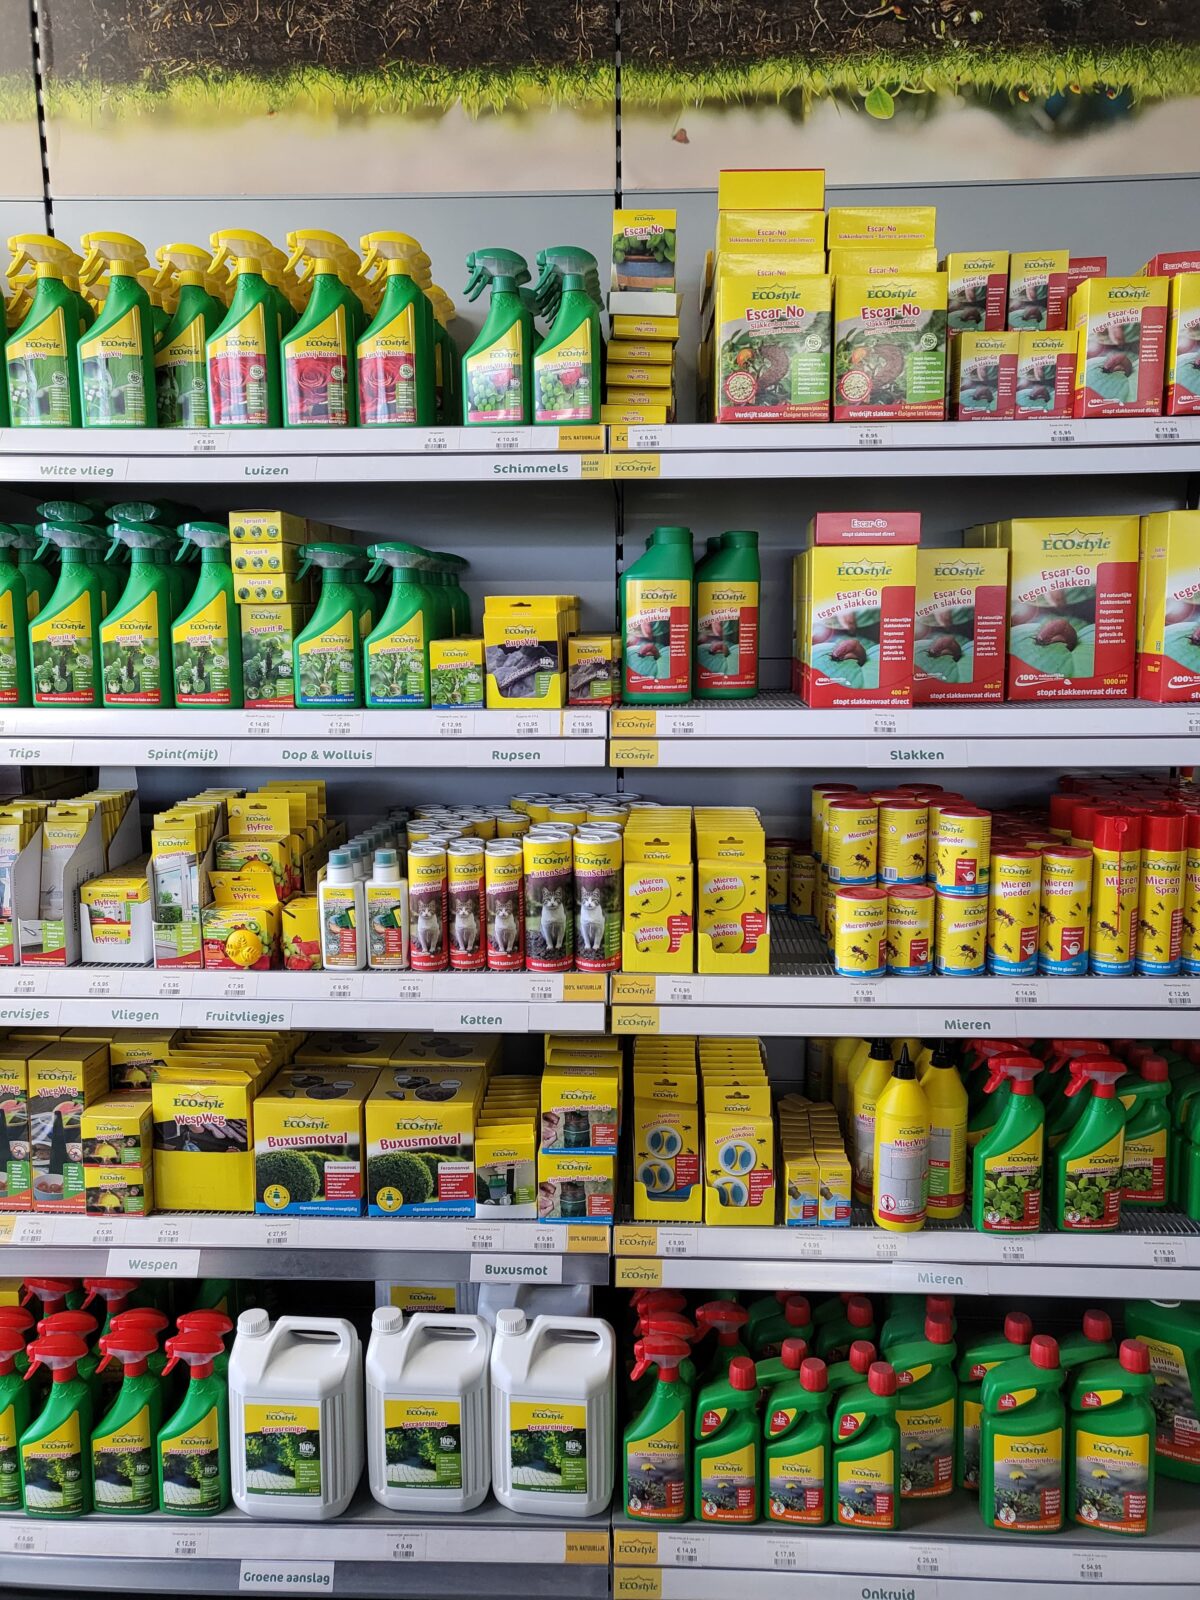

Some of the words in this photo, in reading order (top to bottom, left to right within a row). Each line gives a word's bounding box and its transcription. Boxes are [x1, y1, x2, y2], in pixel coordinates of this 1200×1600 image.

[624, 225, 664, 238] Escar-No
[867, 225, 897, 233] Escar-No
[752, 291, 802, 302] ECOstyle
[867, 289, 917, 301] ECOstyle
[1108, 290, 1151, 301] ECOstyle
[746, 307, 805, 321] Escar-No
[861, 306, 921, 320] Escar-No
[1107, 308, 1139, 320] Escar-Go
[40, 464, 78, 476] Witte
[80, 464, 115, 479] vlieg
[244, 466, 290, 476] Luizen
[492, 463, 569, 474] Schimmels
[615, 465, 658, 473] ECOstyle
[850, 518, 888, 530] Escar-Go
[1040, 536, 1112, 555] ECOstyle
[836, 566, 894, 578] ECOstyle
[933, 567, 987, 578] ECOstyle
[1041, 565, 1091, 582] Escar-Go
[1050, 576, 1091, 592] slakken
[640, 592, 678, 602] ECOstyle
[711, 593, 748, 603] ECOstyle
[836, 588, 878, 601] Escar-Go
[933, 587, 972, 600] Escar-Go
[843, 598, 878, 610] slakken
[941, 597, 972, 608] slakken
[930, 692, 946, 700] stopt
[1036, 689, 1057, 699] stopt
[1057, 689, 1104, 697] slakkenvraat
[1105, 688, 1128, 697] direct
[833, 698, 850, 706] stopt
[851, 698, 888, 706] slakkenvraat
[890, 698, 910, 706] direct
[615, 721, 656, 731] ECOstyle
[8, 747, 42, 760] Trips
[147, 748, 220, 764] Spint(mijt)
[281, 750, 308, 762] Dop
[310, 749, 320, 760] &
[322, 749, 374, 760] Wolluis
[491, 750, 542, 763] Rupsen
[614, 752, 656, 762] ECOstyle
[890, 749, 946, 761] Slakken
[246, 823, 274, 833] FlyFree
[638, 877, 665, 888] Mieren
[712, 876, 739, 887] Mieren
[1000, 881, 1032, 892] Mieren
[1043, 879, 1075, 891] Mieren
[1104, 876, 1139, 887] Mieren
[1144, 876, 1181, 887] Mieren
[633, 885, 665, 896] Lokdoos
[708, 884, 738, 895] Lokdoos
[1002, 888, 1031, 899] poeder
[1044, 887, 1073, 898] poeder
[1154, 885, 1180, 897] Spray
[232, 892, 261, 902] FlyFree
[638, 926, 665, 936] Mieren
[712, 921, 739, 932] Mieren
[709, 928, 738, 940] Lokdoos
[615, 987, 656, 997] ECOstyle
[111, 1009, 160, 1024] Vliegen
[205, 1010, 286, 1025] Fruitvliegjes
[459, 1014, 503, 1025] Katten
[616, 1019, 657, 1027] ECOstyle
[943, 1019, 992, 1030] Mieren
[36, 1073, 78, 1083] ECOstyle
[37, 1086, 79, 1098] VliegWeg
[560, 1093, 598, 1103] ECOstyle
[173, 1098, 225, 1111] ECOstyle
[174, 1113, 226, 1127] WespWeg
[283, 1120, 331, 1131] ECOstyle
[396, 1122, 443, 1133] ECOstyle
[267, 1132, 348, 1148] Buxusmotval
[379, 1132, 461, 1150] Buxusmotval
[556, 1164, 594, 1172] ECOstyle
[618, 1239, 657, 1247] ECOstyle
[127, 1258, 178, 1274] Wespen
[485, 1263, 548, 1276] Buxusmot
[620, 1271, 660, 1282] ECOstyle
[917, 1271, 964, 1285] Mieren
[401, 1420, 448, 1431] Terrasreiniger
[527, 1423, 574, 1433] Terrasreiniger
[1010, 1445, 1049, 1455] ECOstyle
[1092, 1444, 1135, 1458] ECOstyle
[618, 1545, 658, 1556] ECOstyle
[243, 1572, 285, 1583] Groene
[286, 1573, 331, 1585] aanslag
[618, 1582, 659, 1593] ECOstyle
[860, 1588, 916, 1600] Onkruid
